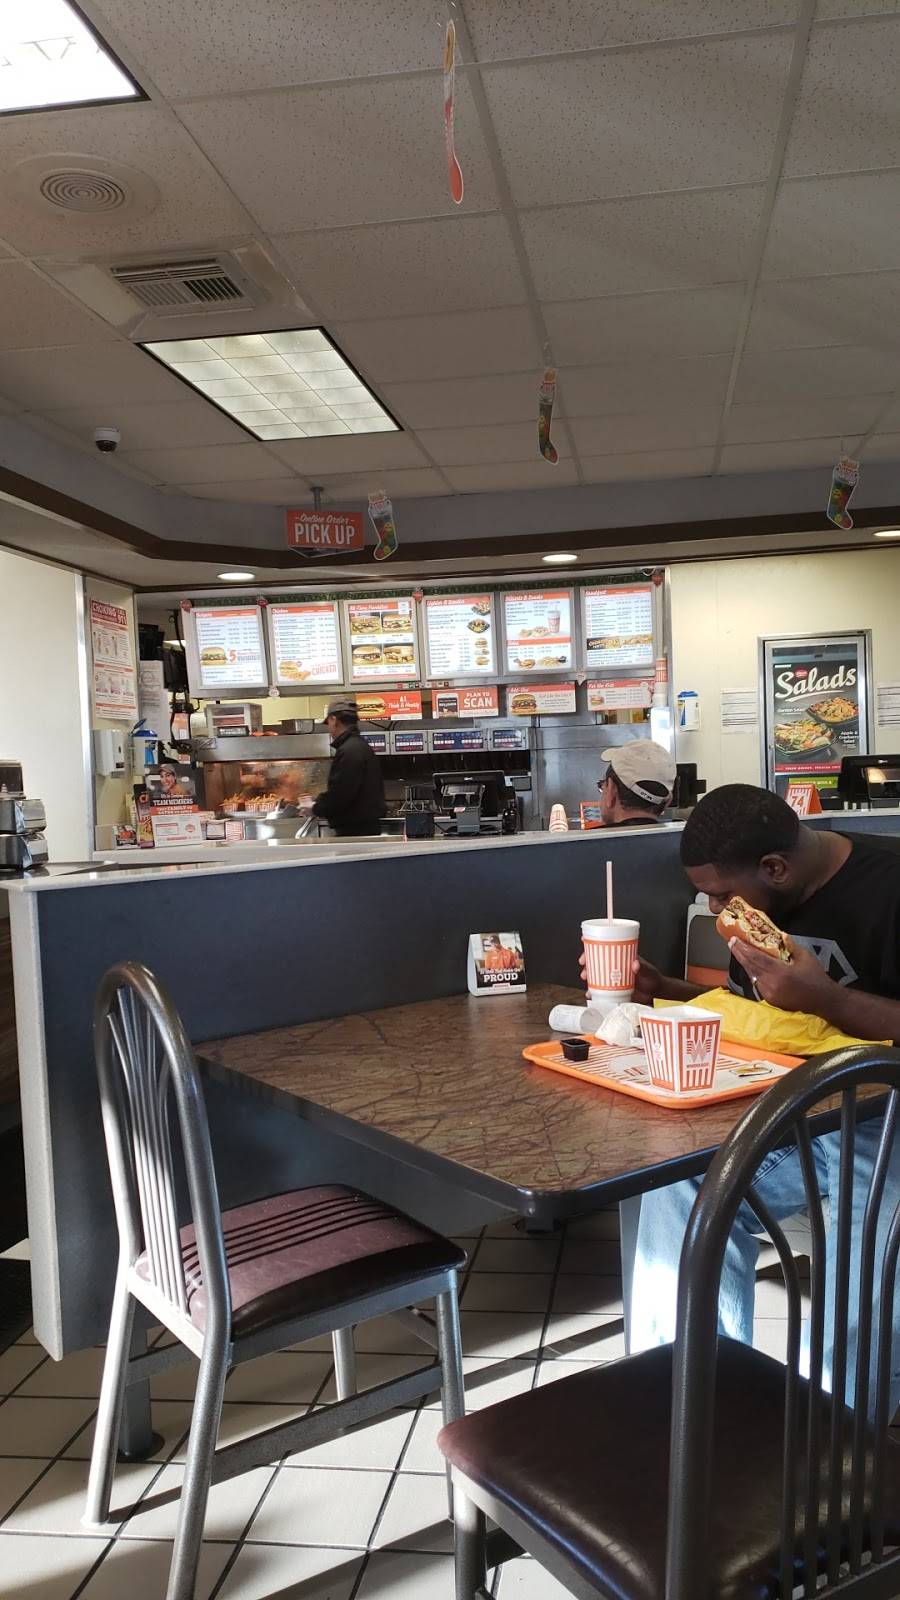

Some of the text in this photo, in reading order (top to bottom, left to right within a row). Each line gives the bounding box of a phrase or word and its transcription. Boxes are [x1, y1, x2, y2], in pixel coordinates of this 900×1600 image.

[299, 513, 349, 524] Online Order
[294, 522, 355, 544] PICK UP
[774, 665, 857, 699] Salads
[463, 697, 492, 708] SCAN
[790, 795, 804, 807] 74
[483, 972, 518, 983] PROUD
